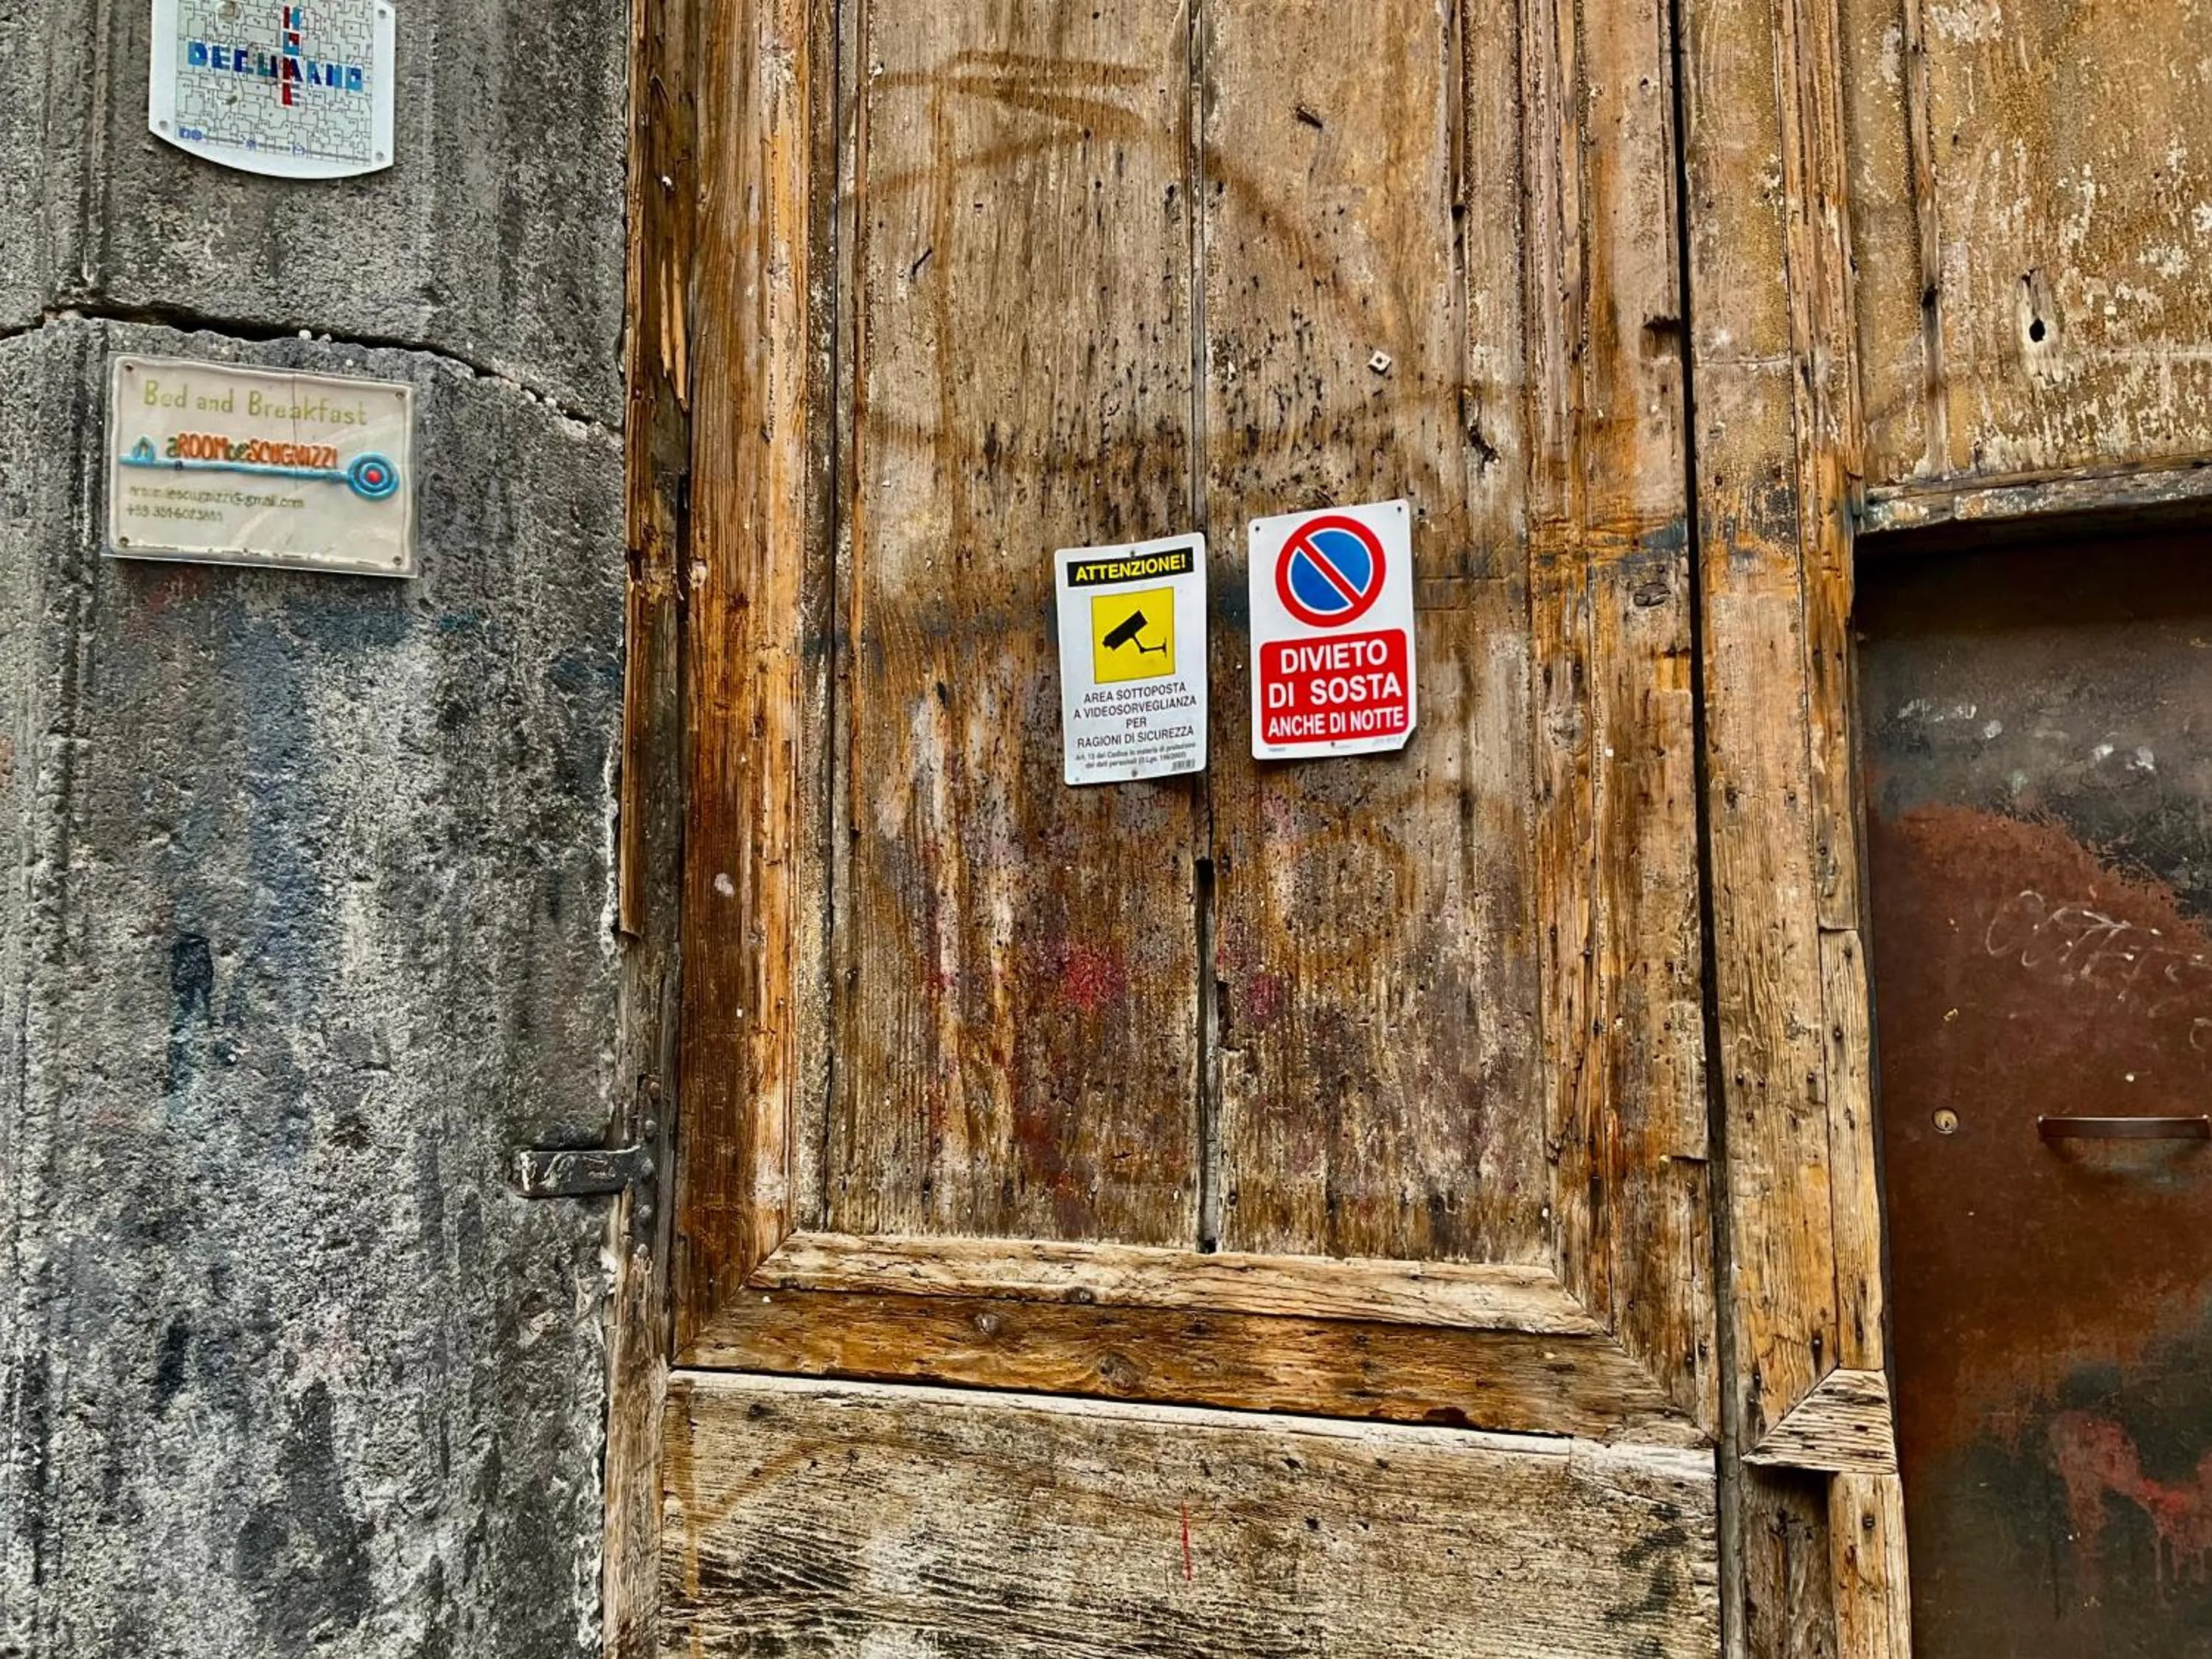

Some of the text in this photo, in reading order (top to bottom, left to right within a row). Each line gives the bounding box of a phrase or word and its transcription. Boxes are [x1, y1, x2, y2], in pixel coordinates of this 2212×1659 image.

[144, 380, 368, 426] Bed and Breakfast
[1075, 554, 1186, 582] ATTENZIONE!
[1281, 639, 1388, 675] DIVIETO
[1084, 682, 1186, 703] AREA SOTTOPOSTA
[1268, 672, 1402, 709] DI SOSTA
[1074, 695, 1197, 720] A VIDEOSORVEGLIANZA
[1267, 706, 1405, 737] ANCHE DI NOTTE
[1077, 726, 1194, 748] RAGIONI DI SICUREZZA
[1126, 717, 1147, 729] PER
